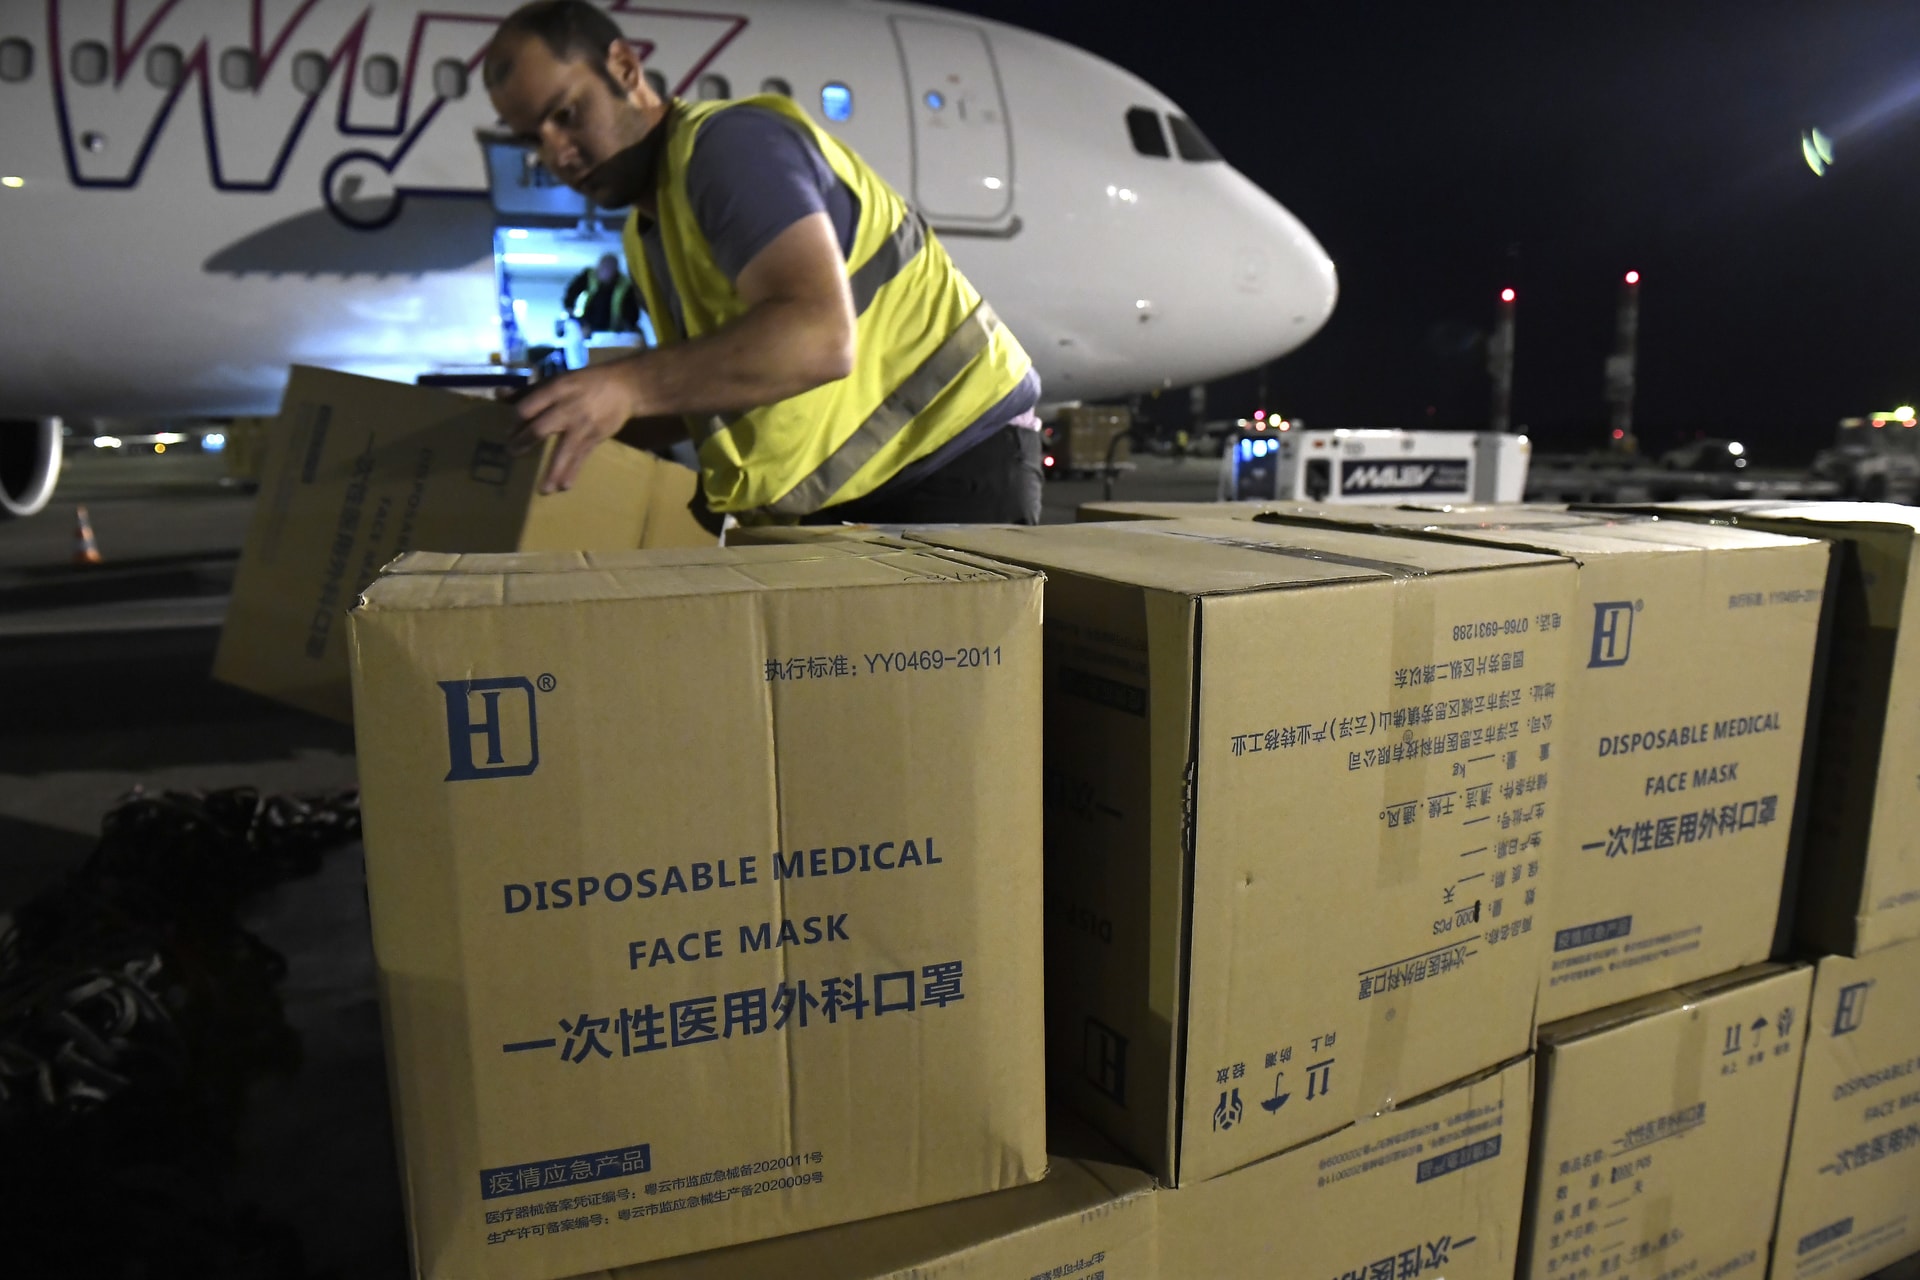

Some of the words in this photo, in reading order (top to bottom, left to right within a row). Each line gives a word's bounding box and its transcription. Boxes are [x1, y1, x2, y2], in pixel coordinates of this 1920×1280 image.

[1394, 650, 1525, 688] 园思劳片区纵二路以东
[1599, 722, 1709, 758] DISPOSABLE
[1713, 712, 1780, 741] MEDICAL
[1453, 763, 1466, 778] kg
[1645, 771, 1687, 796] FACE
[1692, 762, 1739, 788] MASK
[1581, 795, 1778, 858] 一次性医用外科口罩
[503, 855, 757, 914] DISPOSABLE
[772, 836, 943, 880] MEDICAL
[1443, 885, 1456, 904] 天
[628, 929, 723, 971] FACE
[738, 912, 849, 955] MASK
[502, 960, 966, 1065] 一次性医用外科口罩
[1265, 1046, 1292, 1069] 防潮
[1311, 1031, 1336, 1052] 向上
[1216, 1062, 1246, 1084] 轻放
[488, 1149, 646, 1197] 疫情应急产品
